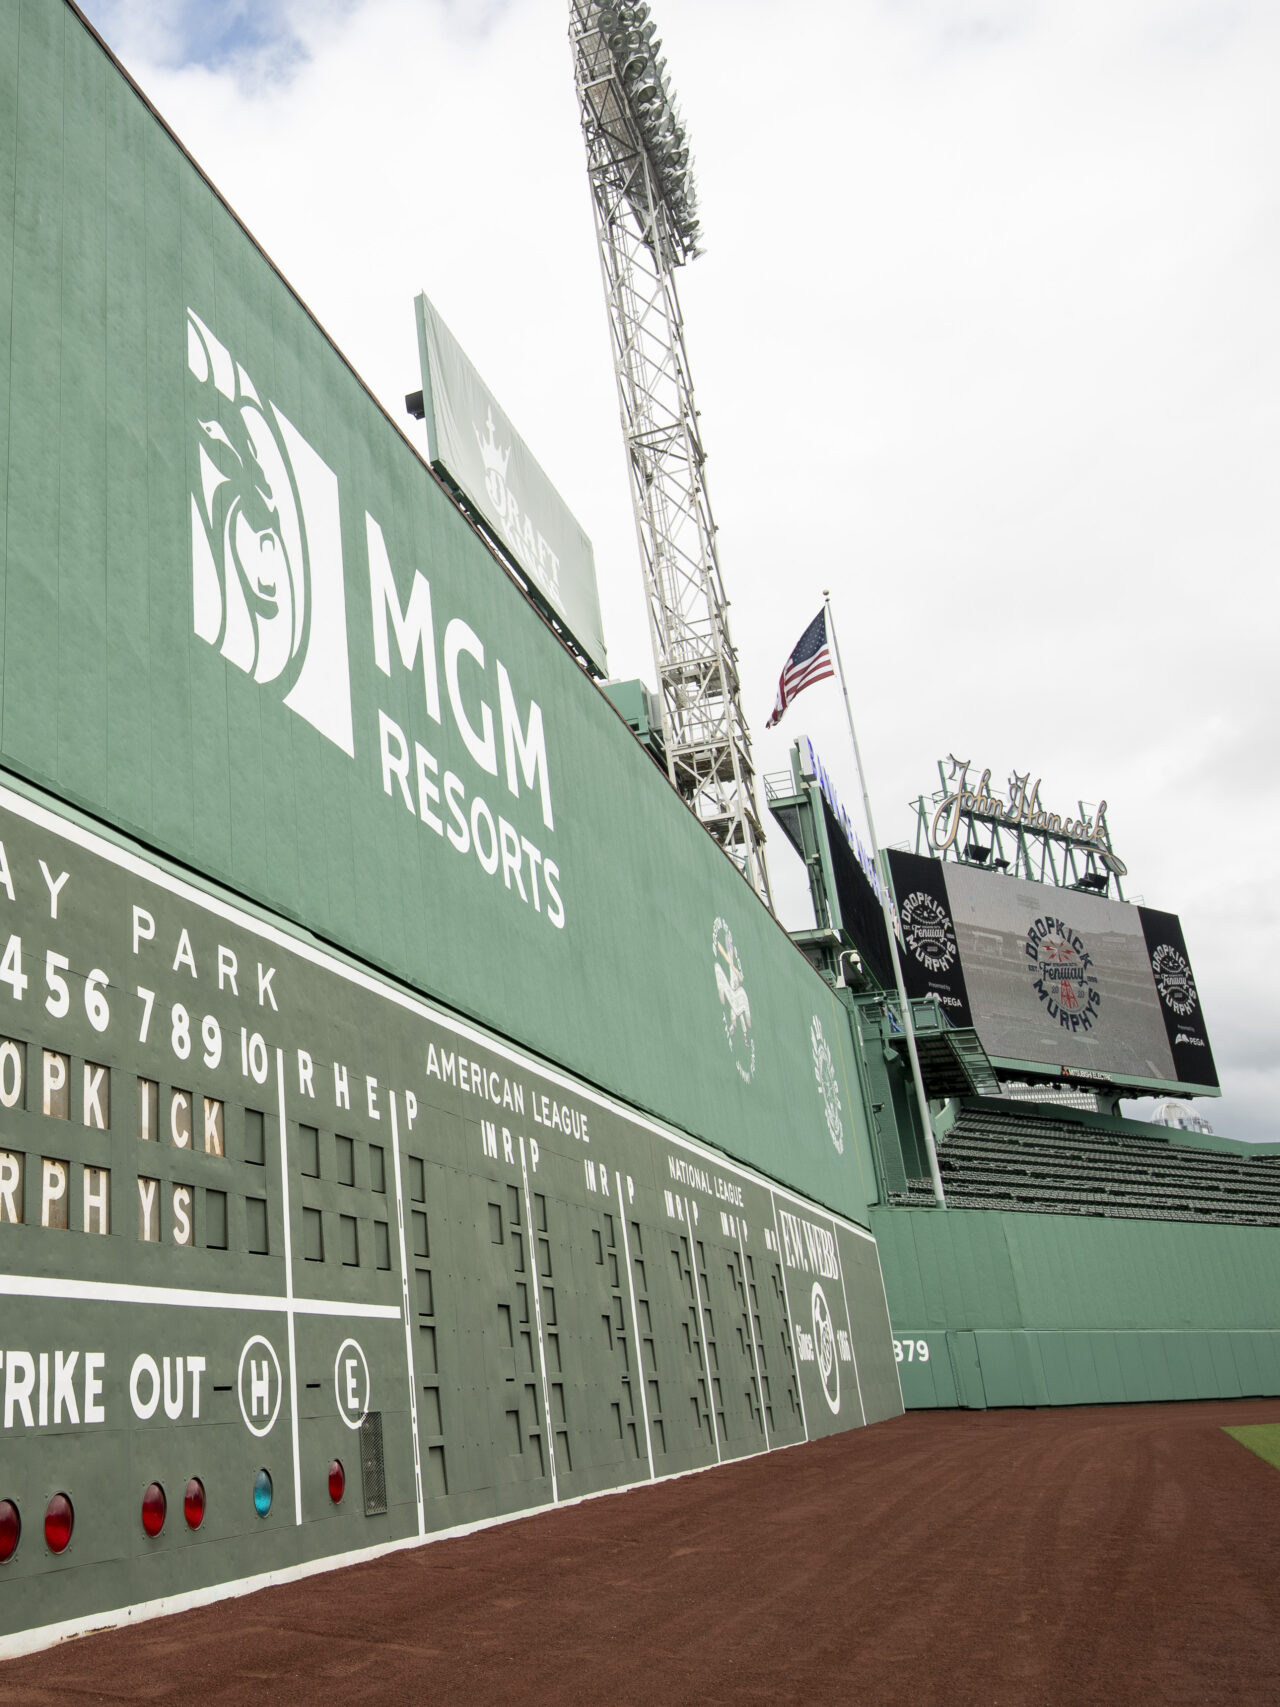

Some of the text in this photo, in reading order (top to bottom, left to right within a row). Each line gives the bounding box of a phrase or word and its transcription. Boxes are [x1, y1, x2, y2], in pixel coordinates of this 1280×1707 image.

[485, 468, 561, 588] DRAFT
[365, 510, 554, 832] MGM
[378, 708, 566, 929] RESORTS
[932, 753, 1005, 850] John
[1004, 769, 1127, 876] Hancock
[901, 891, 952, 931] DROPKICK
[906, 934, 957, 972] MURPHYS
[1026, 916, 1093, 970] DROPKICK
[1152, 944, 1191, 978] DROPKICK
[1039, 962, 1088, 987] Fenway
[1157, 982, 1197, 1016] MURPHYS
[943, 996, 962, 1007] PEGA
[1033, 979, 1101, 1032] MURPHYS
[1189, 1037, 1205, 1047] PEGA
[297, 1049, 418, 1130] R H E P
[426, 1043, 590, 1143] AMERICAN LEAGUE
[502, 1127, 514, 1165] R
[529, 1137, 539, 1172] P
[668, 1155, 744, 1208] NATIONAL LEAGUE
[801, 1219, 839, 1280] WEBB
[129, 1352, 207, 1420] OUT
[251, 1358, 269, 1418] H
[345, 1358, 359, 1409] E
